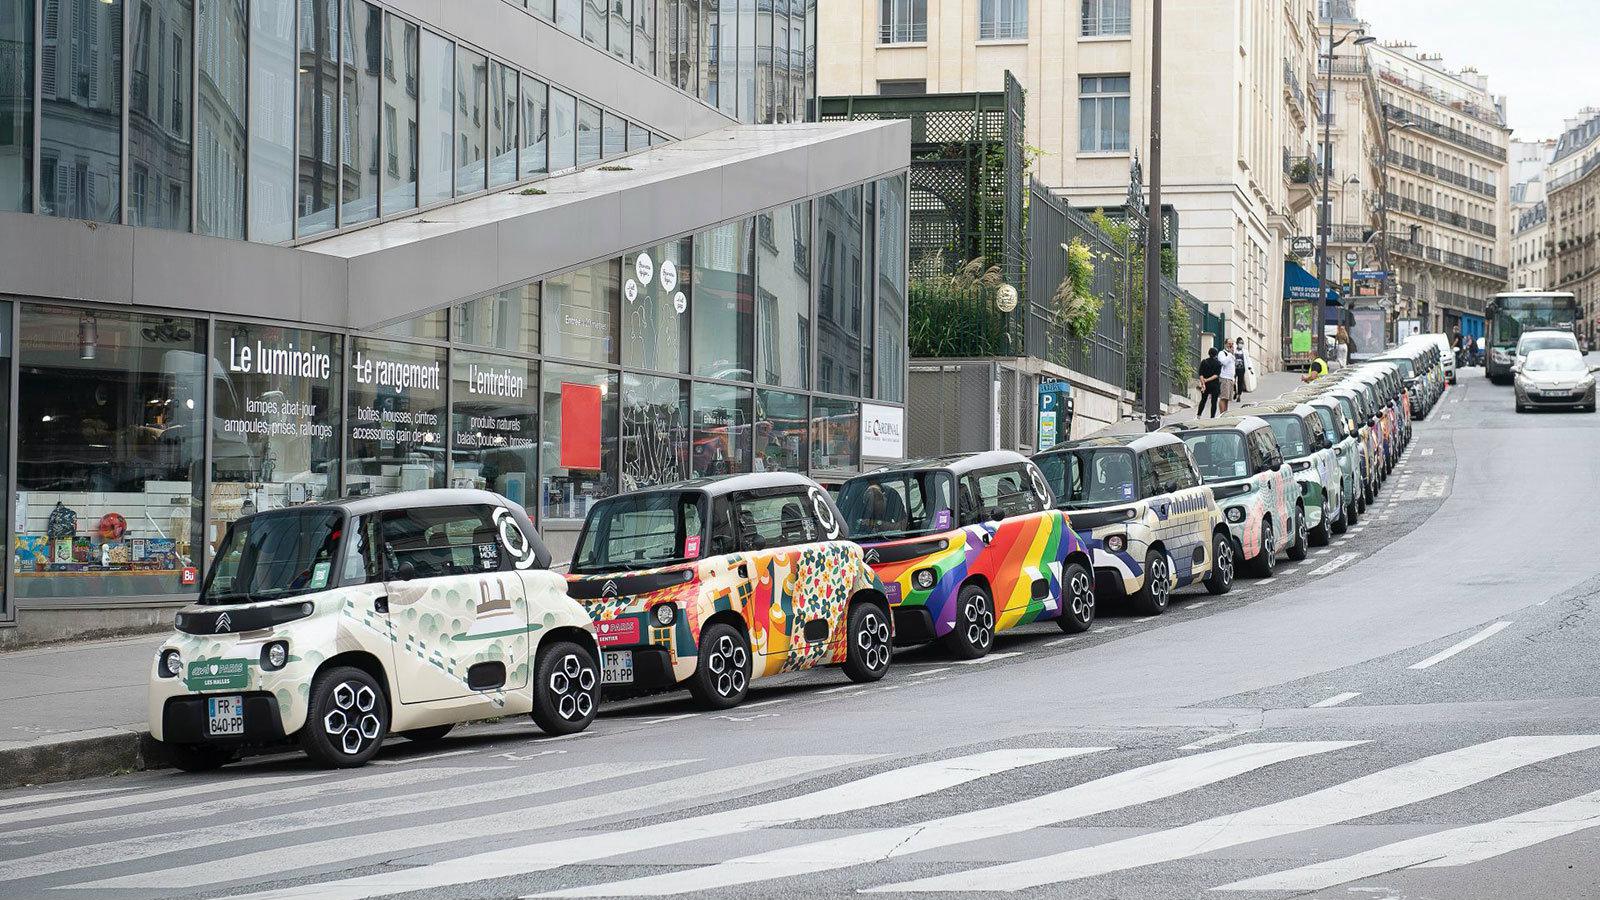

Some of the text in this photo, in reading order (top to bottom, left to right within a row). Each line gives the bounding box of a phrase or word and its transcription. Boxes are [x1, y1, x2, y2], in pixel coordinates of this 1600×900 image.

[230, 337, 330, 380] Le luminaire
[356, 351, 440, 394] Le rangement
[469, 364, 523, 398] L'entretien
[281, 400, 317, 419] abat-jour
[1042, 394, 1053, 410] P
[382, 408, 414, 425] housses,
[414, 411, 438, 425] cintres
[470, 416, 521, 432] produits naturels
[299, 421, 333, 440] rallonges
[352, 427, 395, 442] accessoires
[396, 428, 411, 444] gain
[412, 429, 422, 443] de
[864, 419, 899, 436] LE CARDINAL
[509, 435, 533, 449] brosses
[219, 662, 243, 674] PARIS
[211, 717, 243, 733] 640-PP
